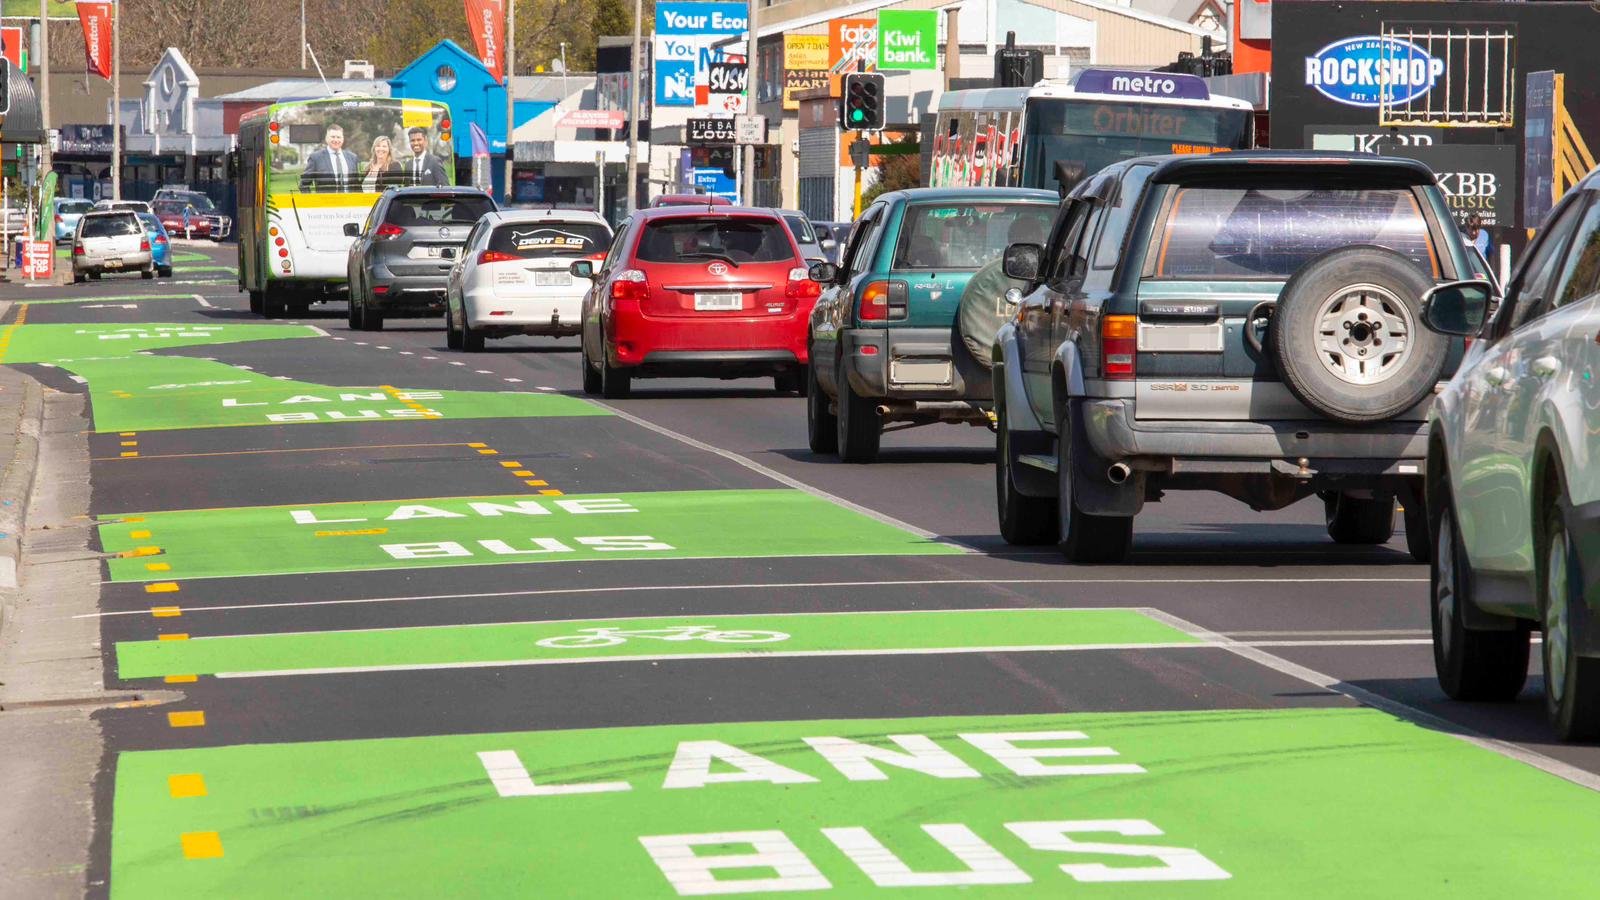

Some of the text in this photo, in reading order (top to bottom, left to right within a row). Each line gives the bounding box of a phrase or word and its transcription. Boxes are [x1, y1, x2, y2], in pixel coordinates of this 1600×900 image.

[663, 10, 708, 28] Your
[482, 9, 496, 68] Explore
[884, 30, 921, 46] Kiwi
[884, 47, 931, 63] bank.
[1345, 42, 1402, 52] NEW ZEAAND
[787, 69, 829, 78] Asian
[1305, 57, 1444, 86] ROCKSHOP
[787, 79, 829, 89] MART
[1112, 76, 1175, 94] metro
[692, 121, 737, 130] THE BA
[1093, 106, 1187, 135] Orbiter
[1433, 172, 1497, 196] KBB
[555, 236, 565, 244] 2
[1183, 305, 1209, 313] SURF
[221, 391, 444, 407] LANE
[265, 408, 444, 422] BUS
[289, 498, 640, 525] LANE
[379, 535, 677, 560] BUS
[475, 730, 1147, 797] LANE
[637, 818, 1233, 897] BUS
